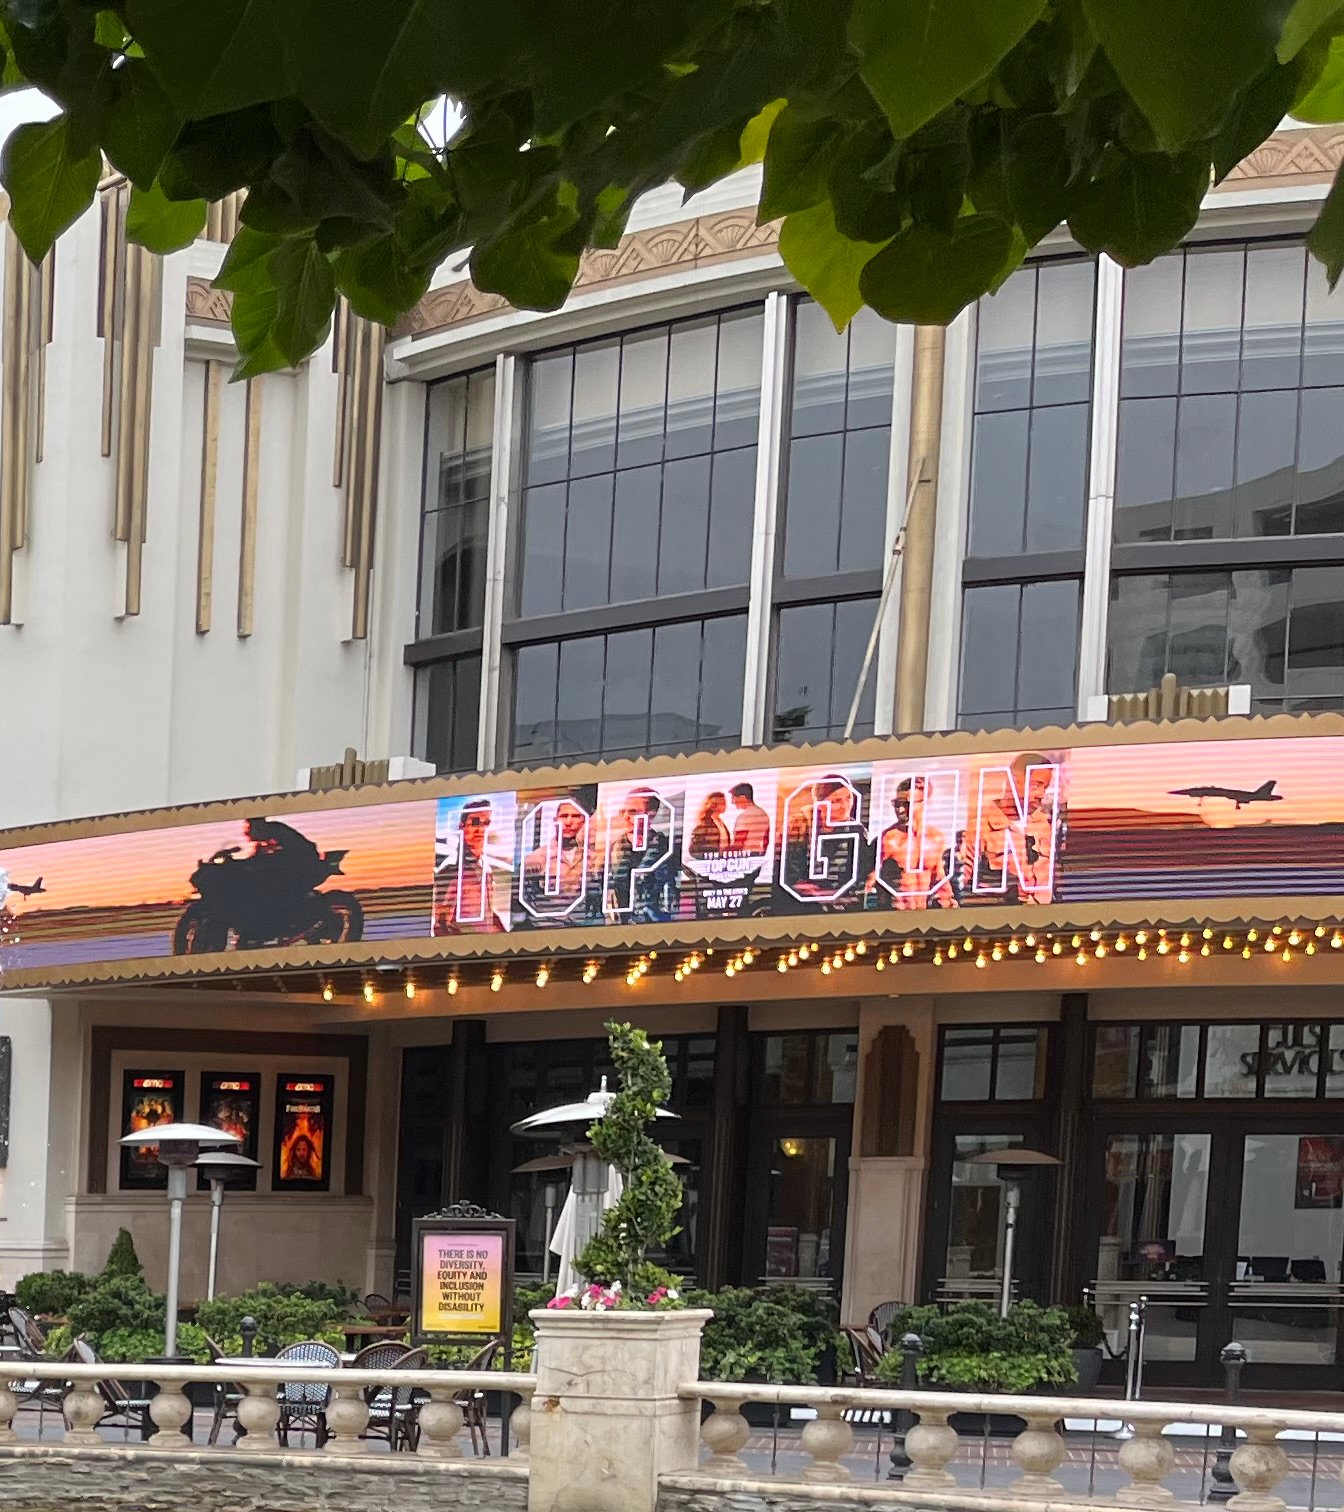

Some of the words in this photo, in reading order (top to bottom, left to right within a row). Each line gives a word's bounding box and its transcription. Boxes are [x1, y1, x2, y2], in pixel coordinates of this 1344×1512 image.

[448, 790, 676, 923] TOP
[778, 763, 1061, 902] GUN
[707, 896, 728, 910] MAY
[728, 895, 743, 909] 27
[438, 1249, 464, 1259] THERE
[466, 1249, 474, 1259] IS
[476, 1250, 488, 1260] NO
[437, 1270, 467, 1280] EQUITY
[469, 1271, 488, 1281] AND
[439, 1281, 485, 1291] INCLUSION
[442, 1292, 482, 1301] WITHOUT
[438, 1302, 485, 1312] DISABILITY
